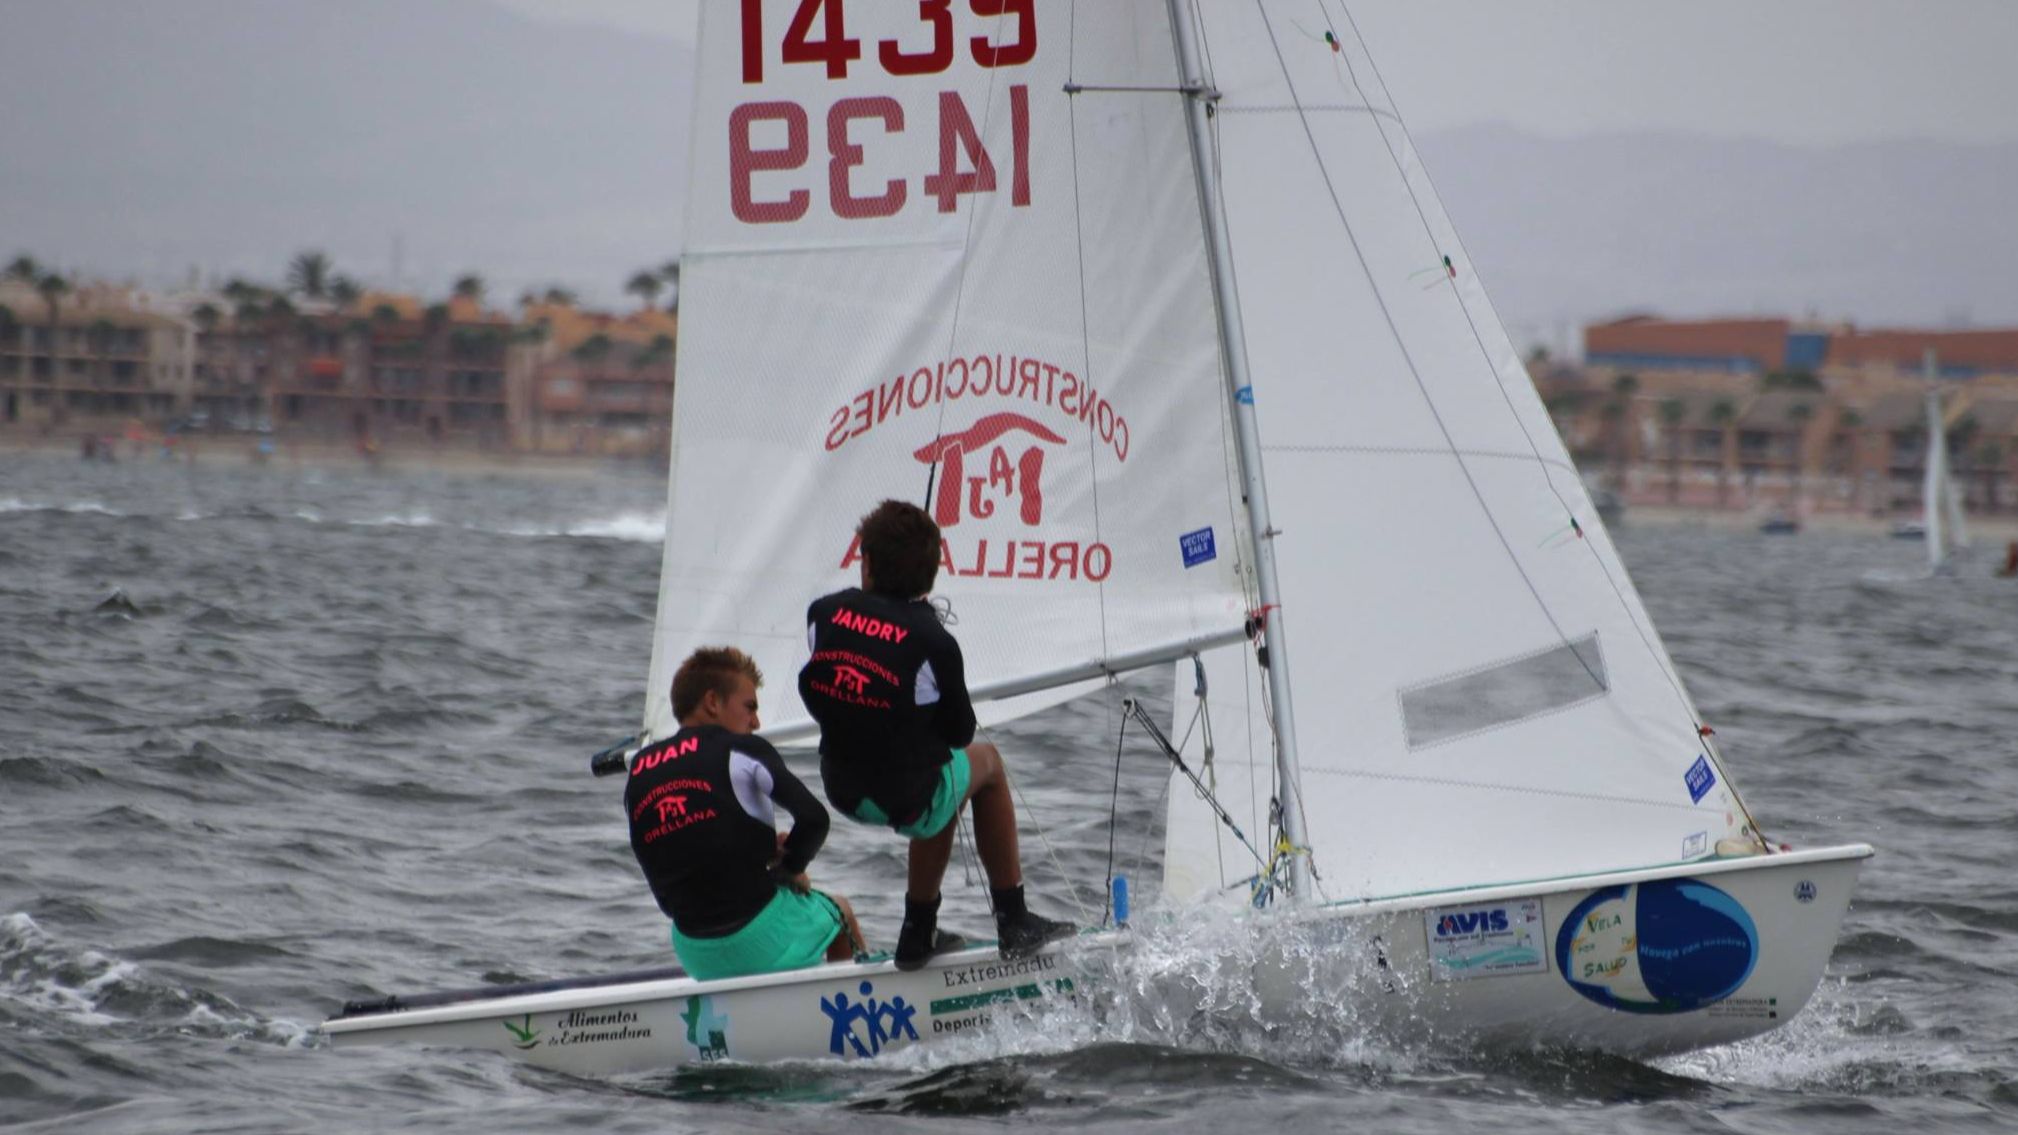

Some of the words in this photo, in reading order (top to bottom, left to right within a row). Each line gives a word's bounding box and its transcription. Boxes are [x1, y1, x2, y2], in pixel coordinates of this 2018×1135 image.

[740, 0, 1037, 84] 1439
[832, 608, 908, 644] JANDRY
[810, 680, 891, 709] ORELLANA
[632, 736, 698, 776] JUAN
[633, 779, 712, 822] CONSTRUCCIONES
[643, 809, 716, 844] ORELLANA
[1437, 909, 1509, 936] AVIS
[943, 954, 1057, 988] Extremadu
[1584, 956, 1627, 978] SALUD
[558, 1010, 638, 1029] Alimentos
[932, 1013, 992, 1034] Deport
[560, 1026, 651, 1046] Extremadura
